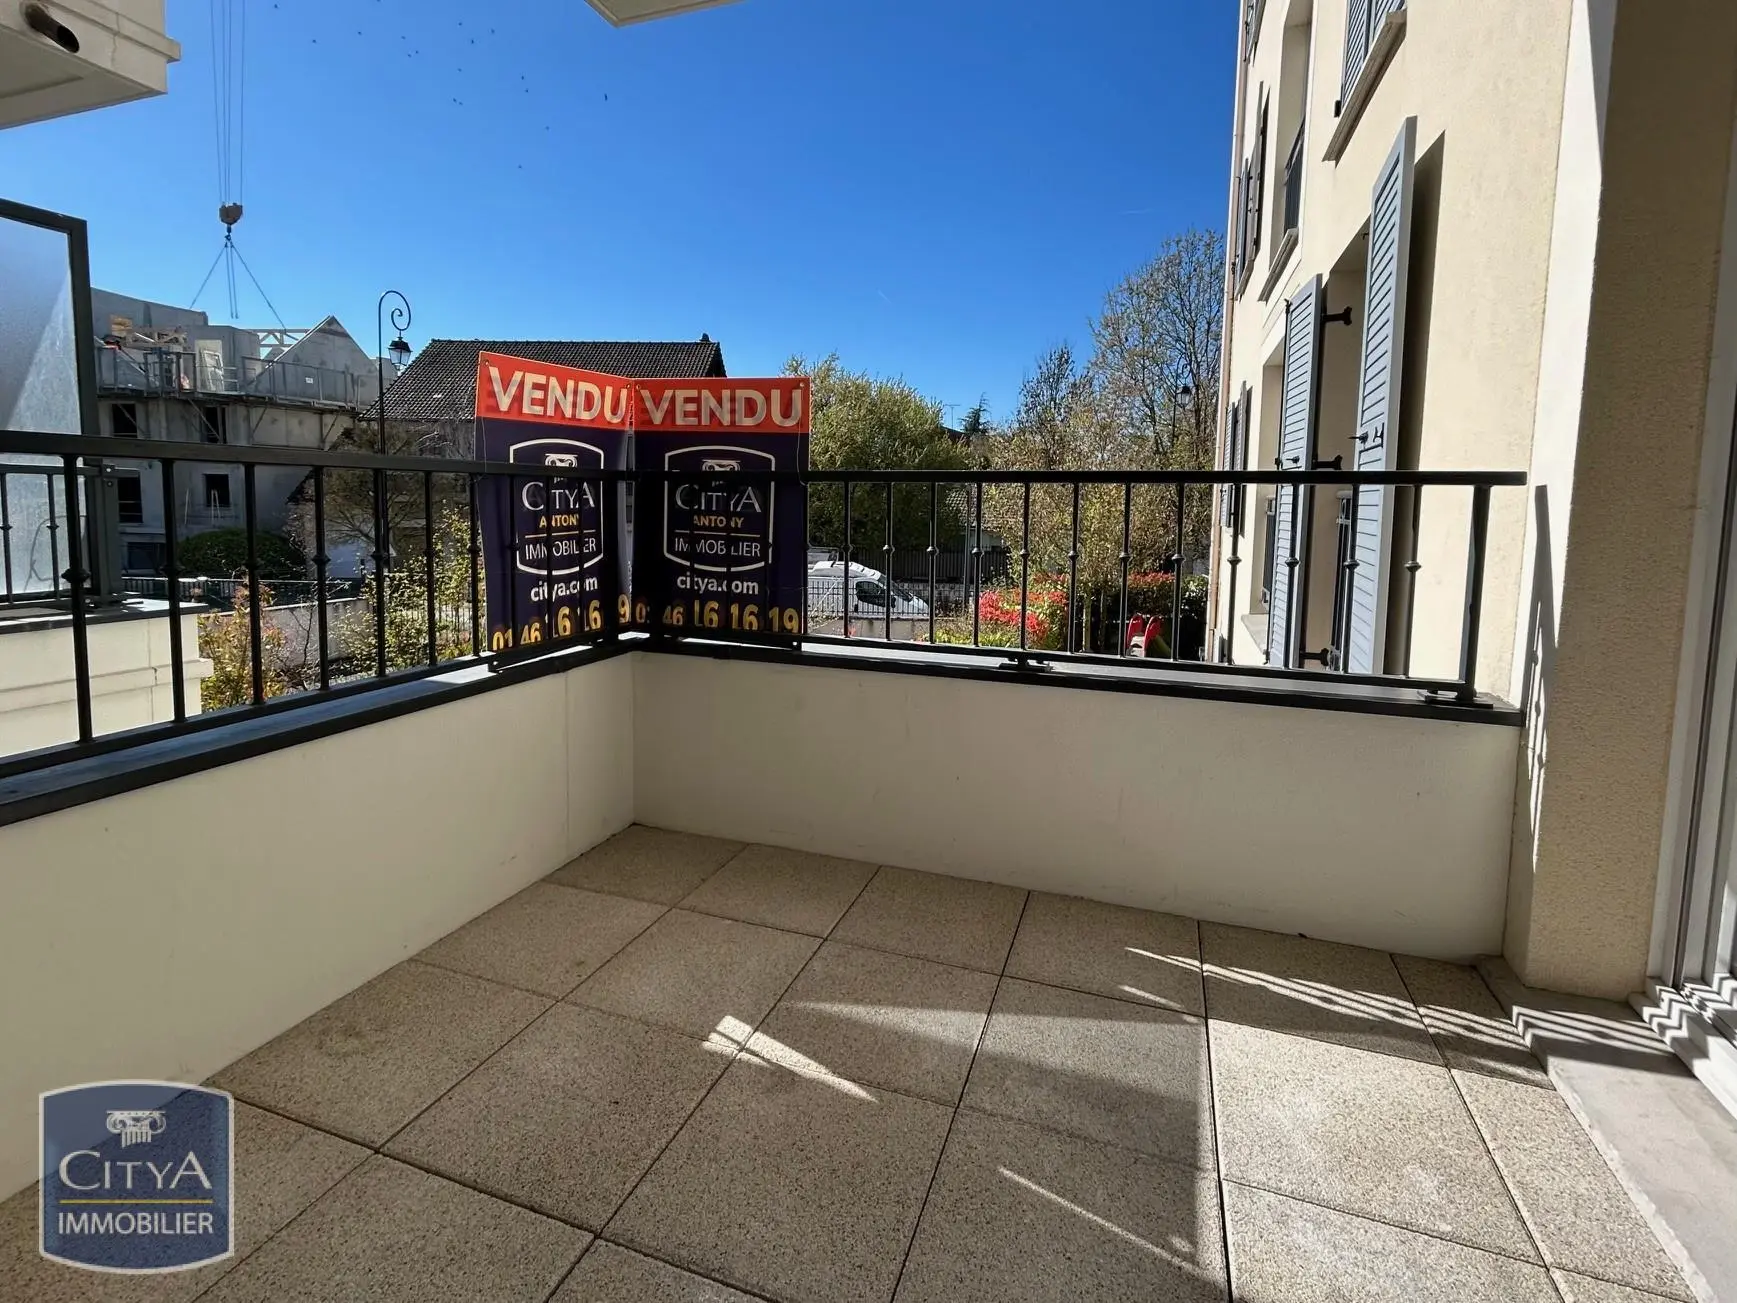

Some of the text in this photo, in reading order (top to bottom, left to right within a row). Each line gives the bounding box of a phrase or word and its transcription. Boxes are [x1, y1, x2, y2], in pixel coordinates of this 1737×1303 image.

[489, 366, 628, 424] VENDU
[640, 389, 802, 427] VENDU
[522, 481, 595, 511] CTYA
[675, 484, 762, 513] CITYA
[539, 513, 580, 528] ATON
[525, 537, 597, 560] IMMOBILER
[674, 537, 761, 557] IMMOBLIER
[635, 599, 800, 634] 0 46 16 16 19
[520, 622, 542, 645] 46
